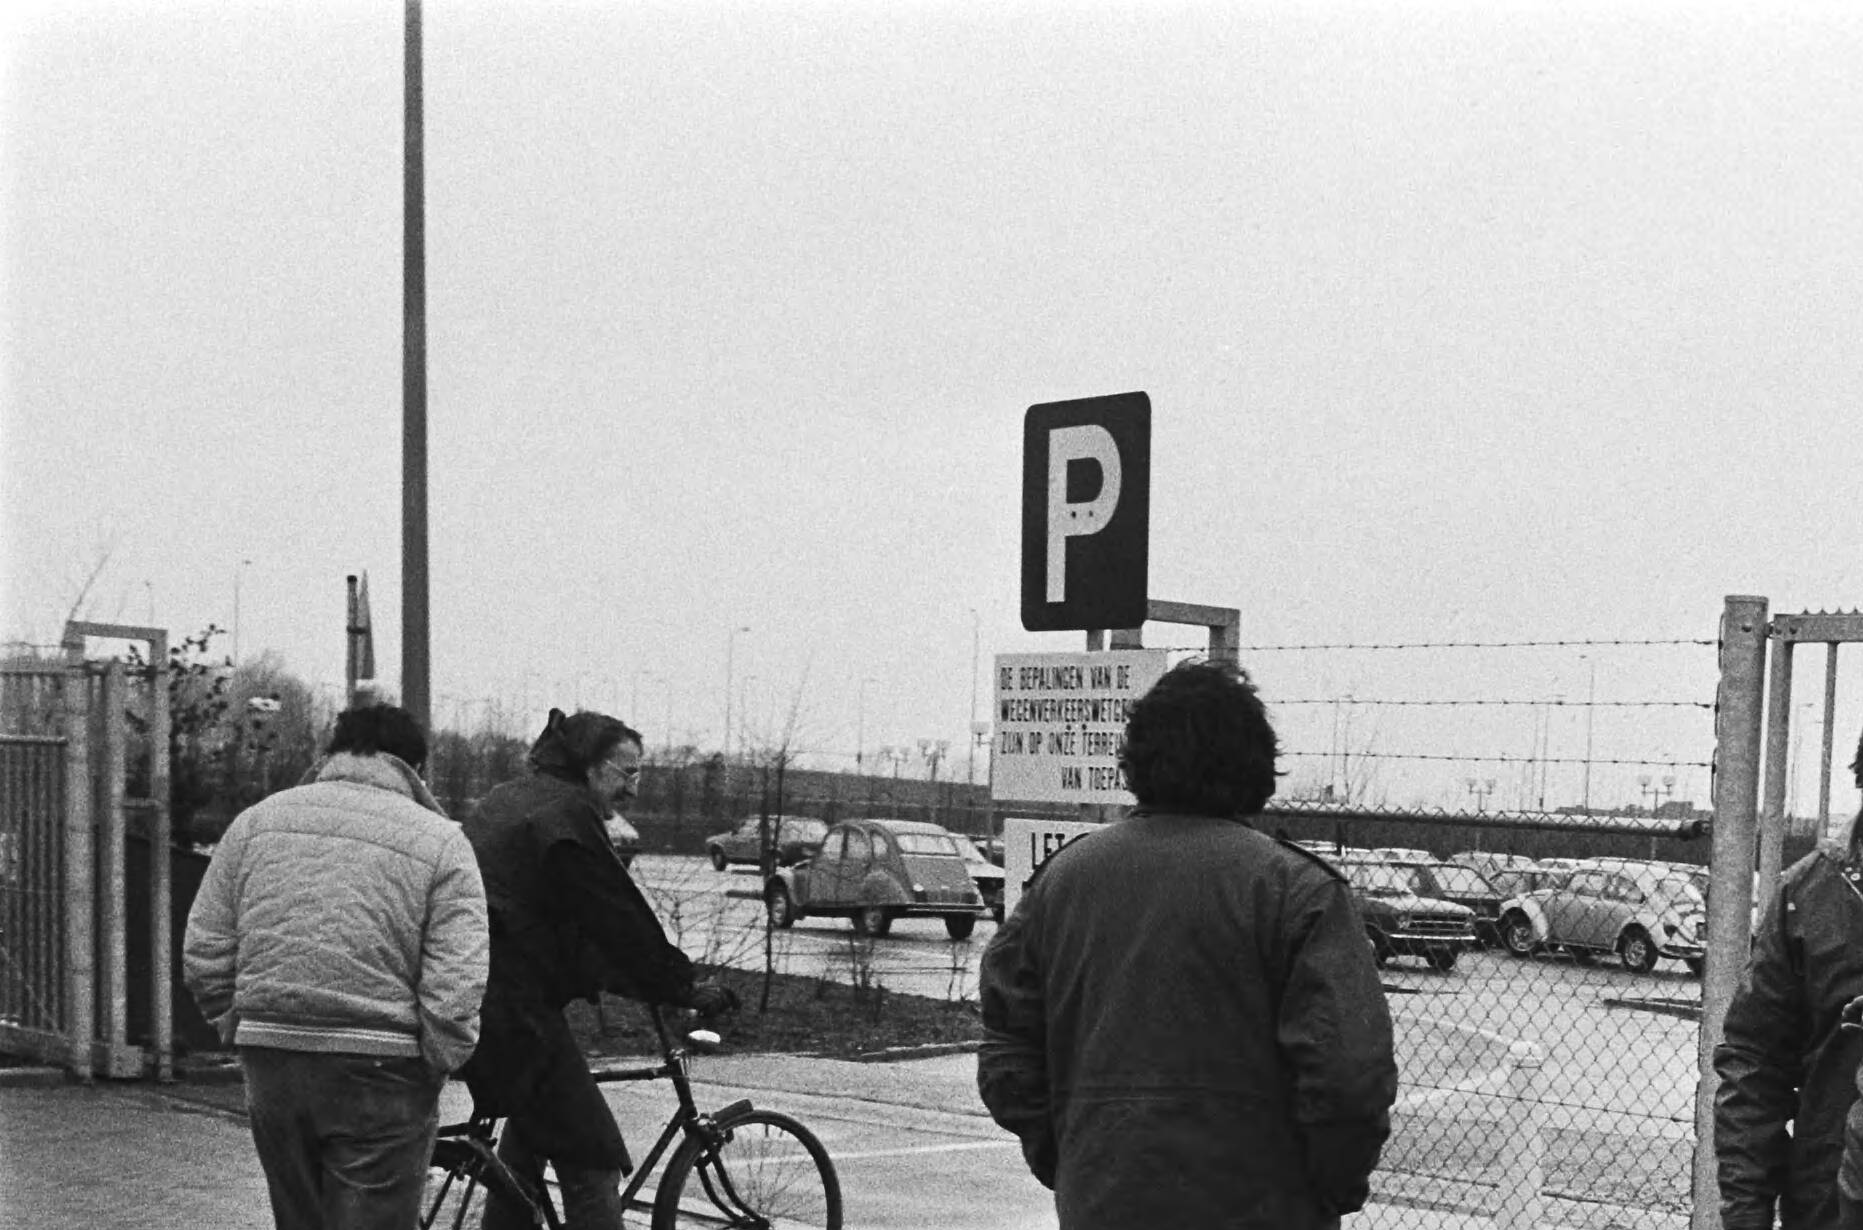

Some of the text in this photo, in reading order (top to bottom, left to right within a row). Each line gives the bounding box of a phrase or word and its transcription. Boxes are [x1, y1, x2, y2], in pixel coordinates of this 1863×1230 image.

[1046, 424, 1122, 604] P
[1001, 664, 1130, 690] DE BEPALINGEN VAN DE
[1029, 731, 1041, 754] OP
[1049, 731, 1075, 755] ONZE
[1062, 767, 1082, 790] VAN
